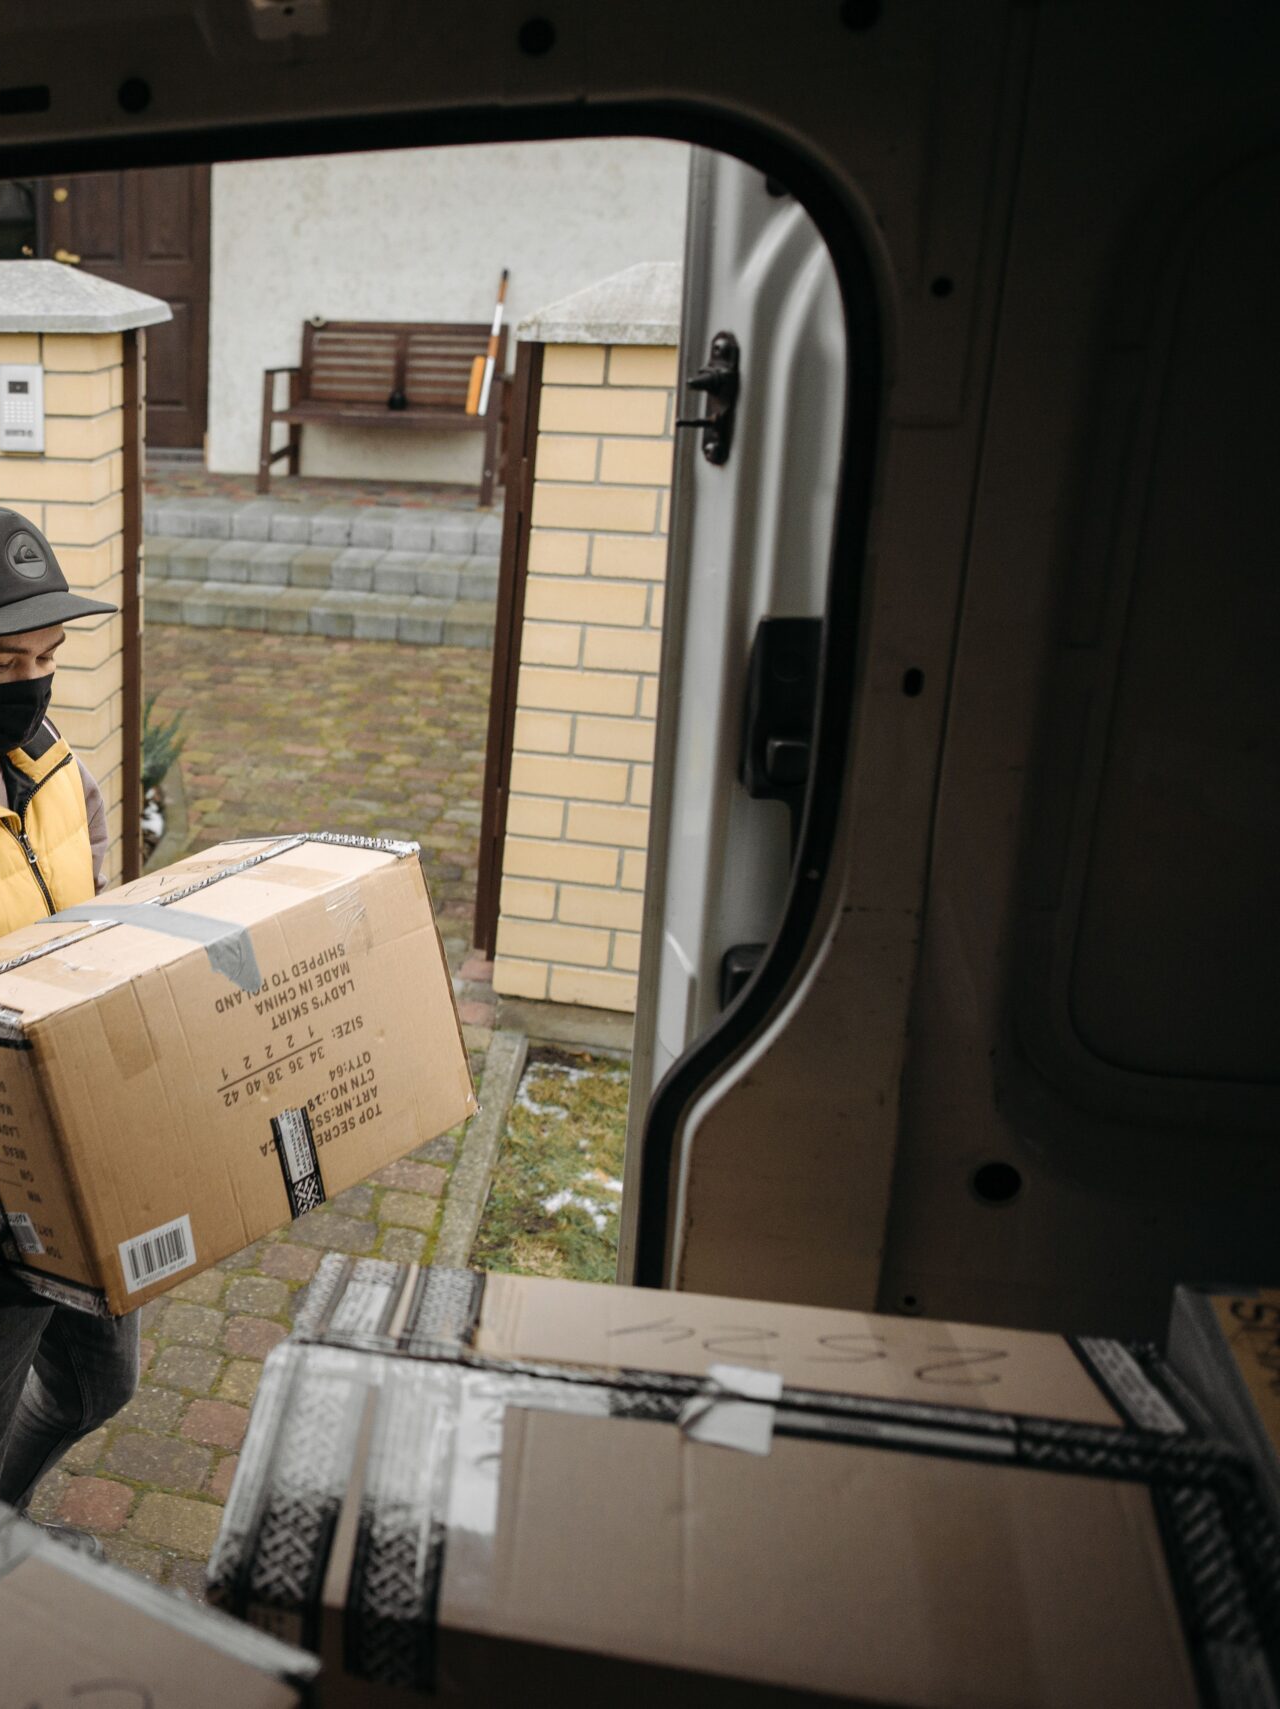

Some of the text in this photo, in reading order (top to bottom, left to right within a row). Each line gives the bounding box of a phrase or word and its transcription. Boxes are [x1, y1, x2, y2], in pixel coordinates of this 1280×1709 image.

[291, 943, 346, 977] SHIPPED
[255, 960, 351, 1016] MADE IN CHINA
[271, 969, 290, 987] TO
[271, 979, 356, 1031] LADY'S SKIRT
[331, 1015, 364, 1039] SIZE:
[220, 1025, 315, 1082] 1 2 2 2 1
[328, 1051, 372, 1082] QTY:64
[223, 1046, 325, 1107] 34 36 38 40 42
[351, 1068, 375, 1092] CTN
[358, 1103, 383, 1125] TOP
[316, 1120, 356, 1148] SECRE
